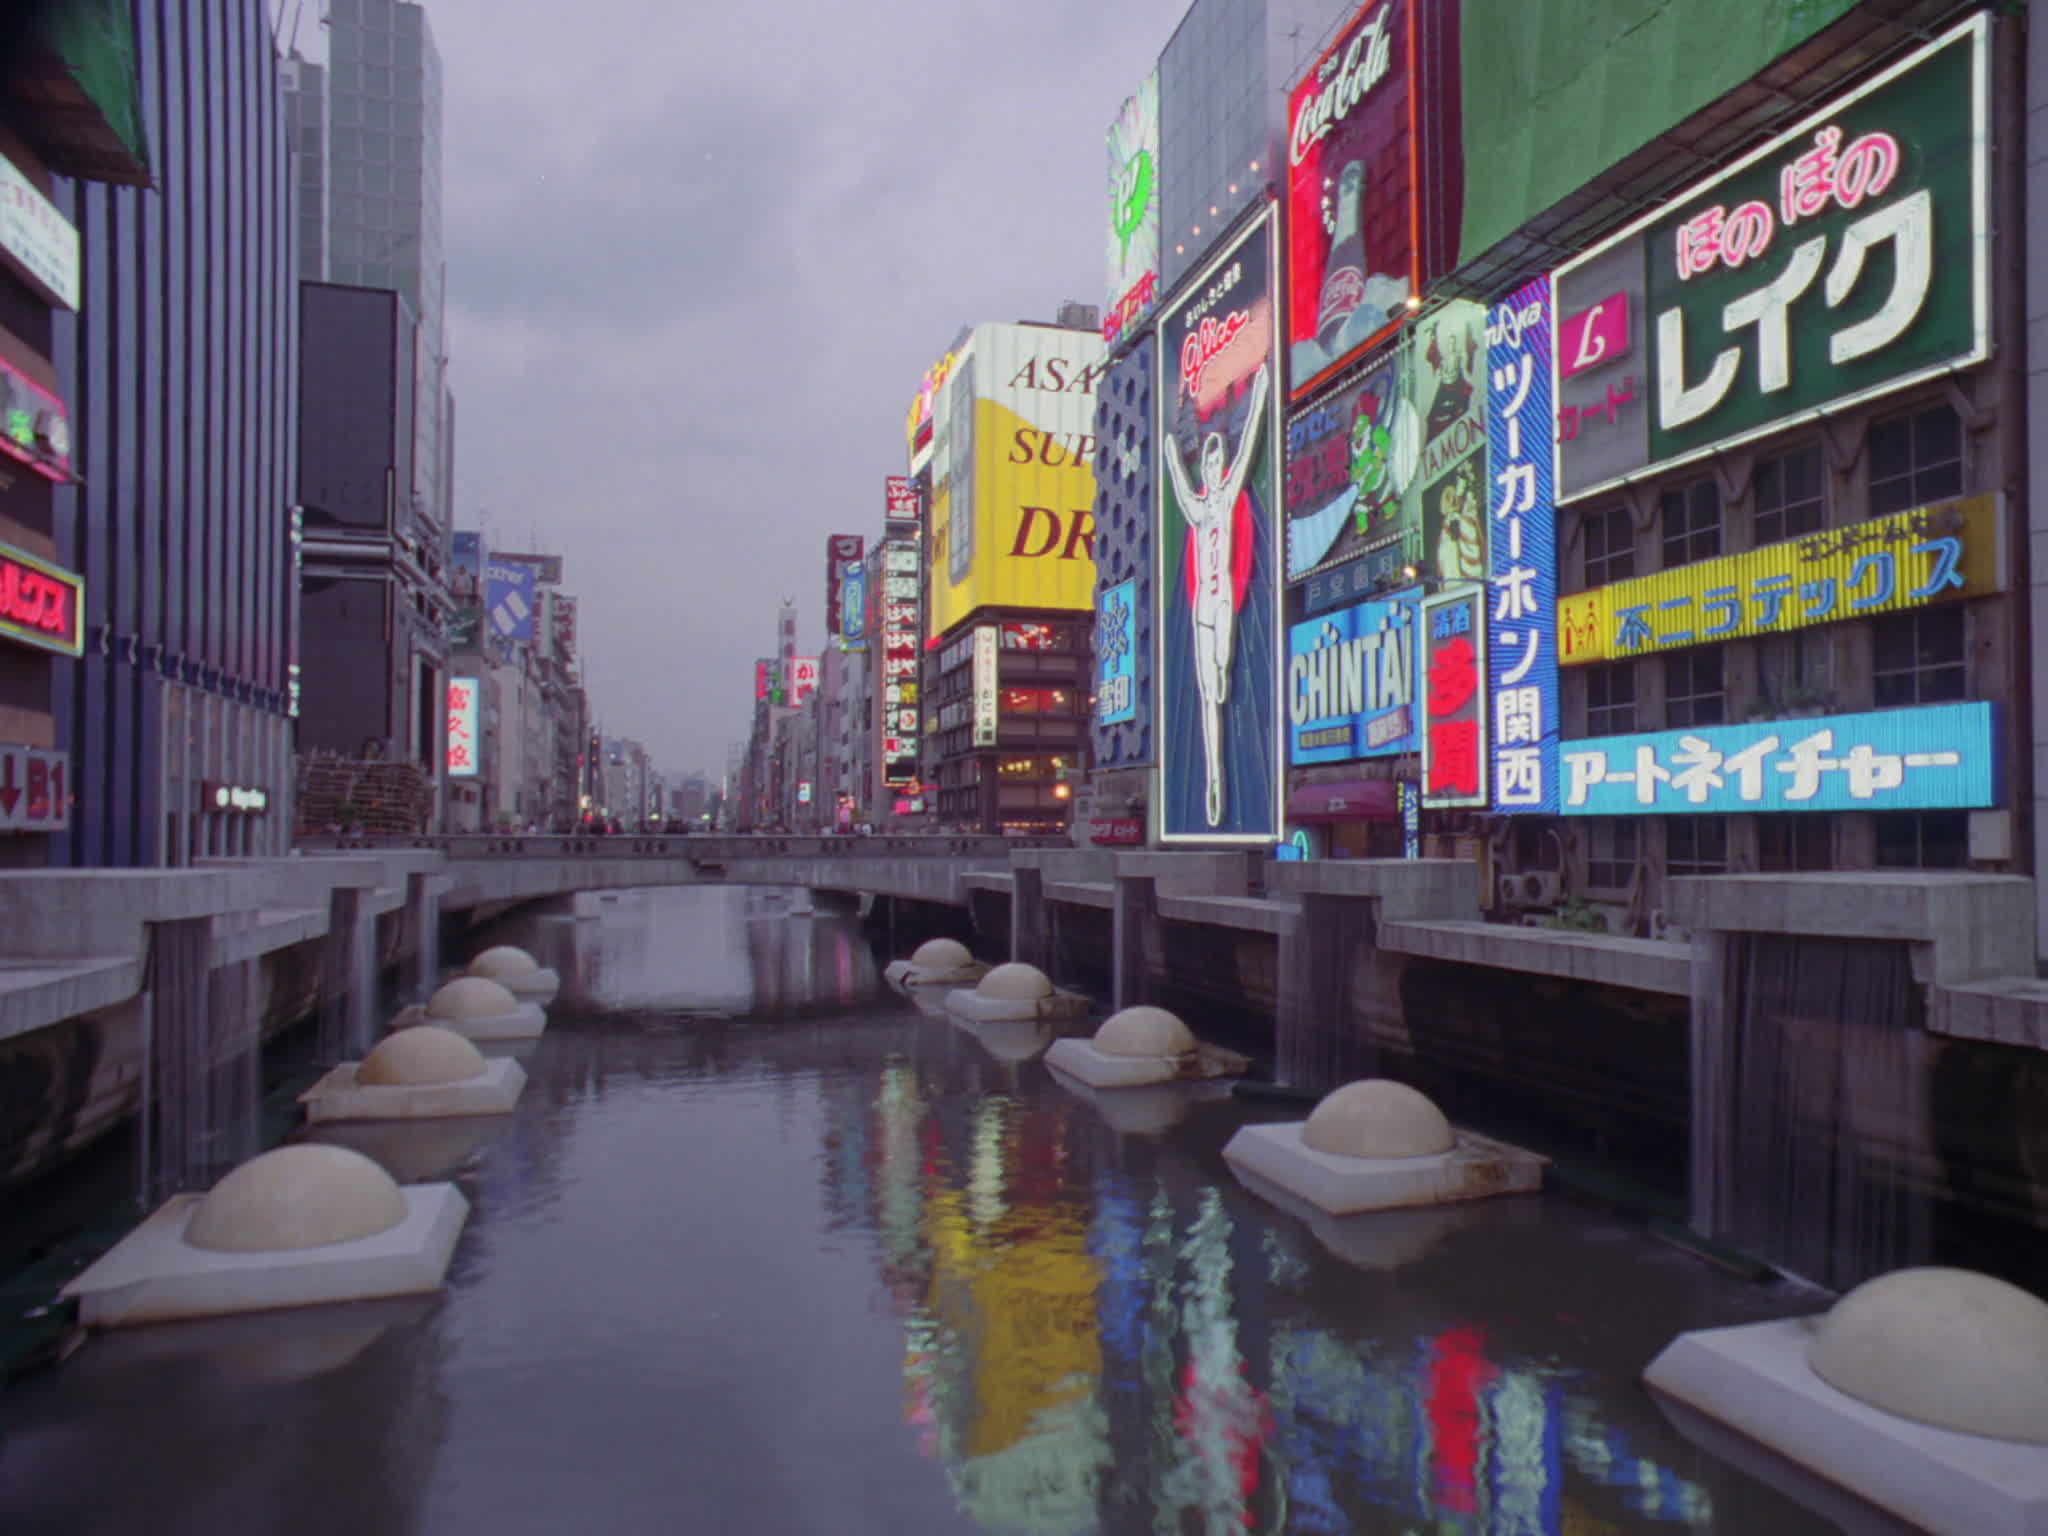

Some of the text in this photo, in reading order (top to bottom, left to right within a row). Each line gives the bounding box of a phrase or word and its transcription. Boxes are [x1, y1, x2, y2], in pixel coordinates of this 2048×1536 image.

[1676, 126, 1898, 280] ほのぼの
[1181, 310, 1250, 398] Glico
[1658, 188, 1932, 430] レイク
[1494, 353, 1541, 805] ツーカーホン関西
[1614, 536, 1964, 649] 不二ラテックス
[1289, 615, 1413, 727] CHINTAI
[27, 756, 65, 821] B1
[1562, 728, 1961, 806] アートネイチャー
